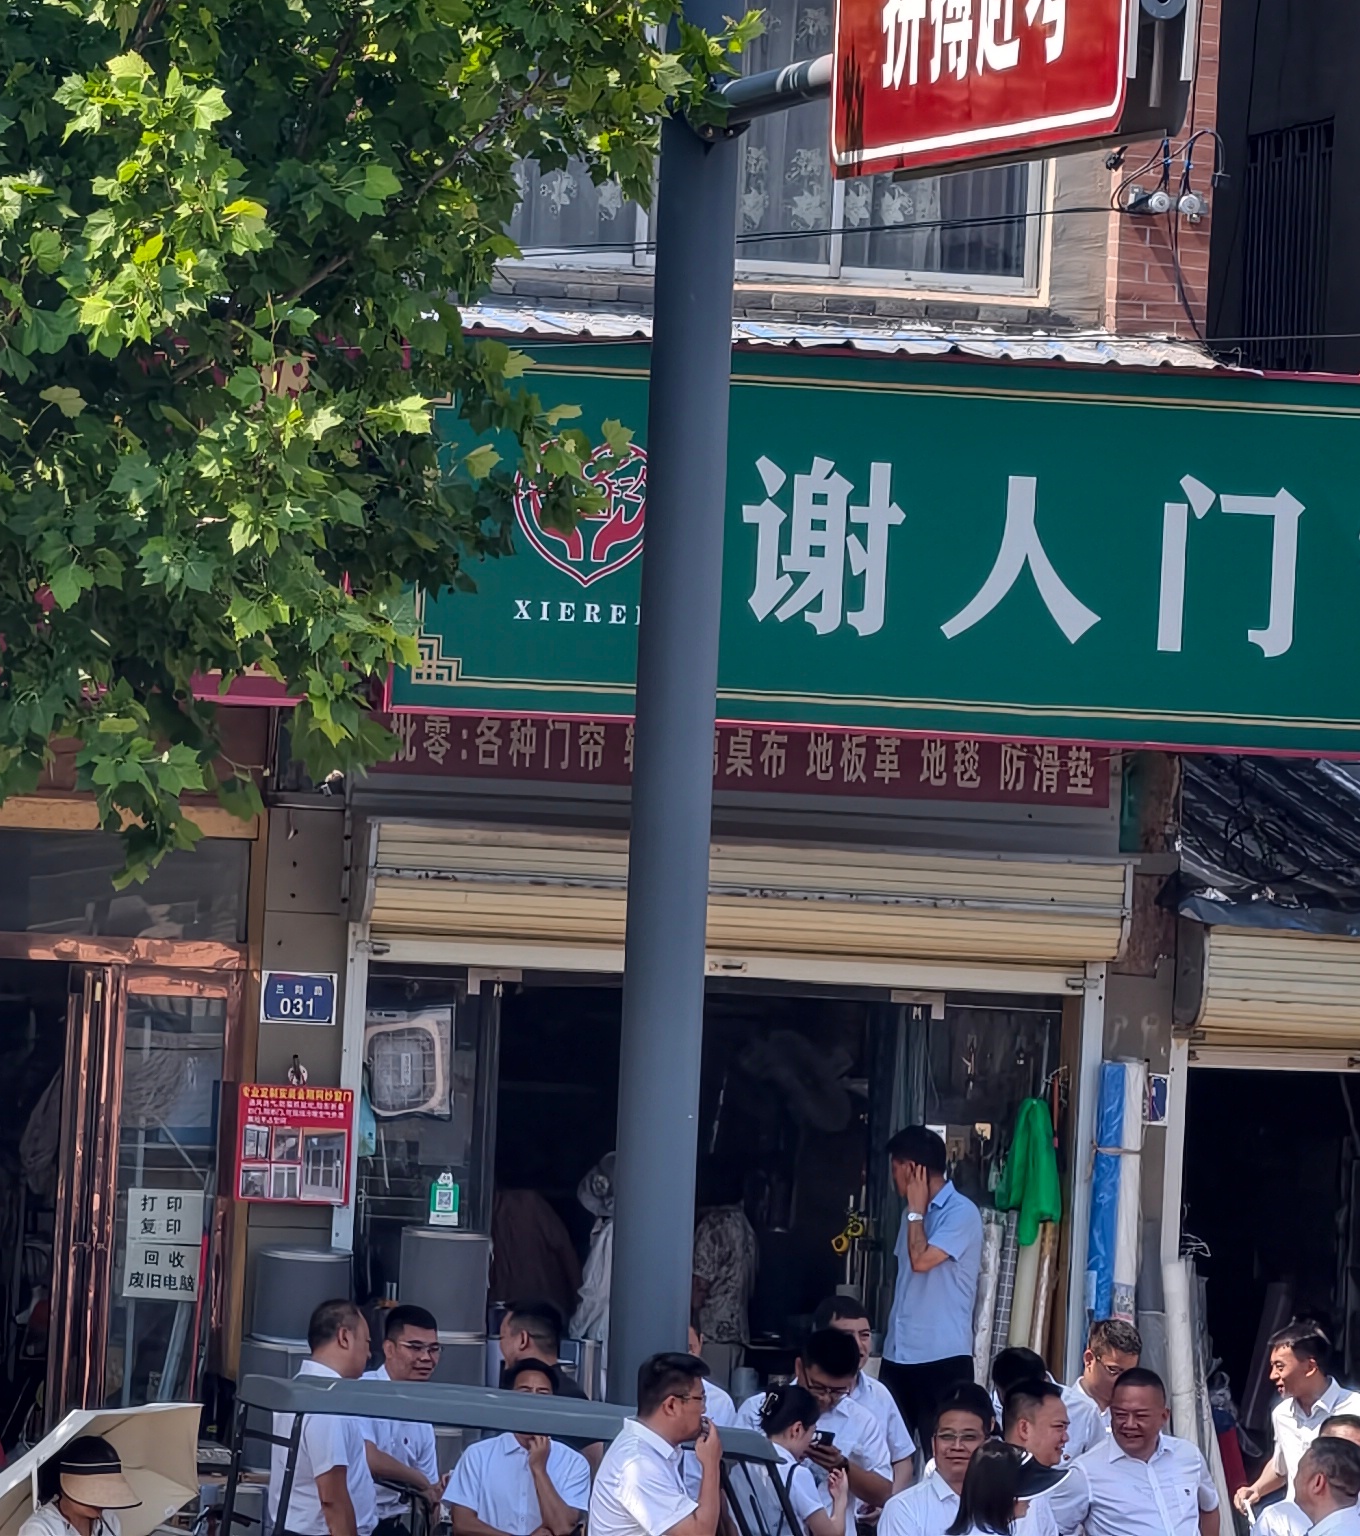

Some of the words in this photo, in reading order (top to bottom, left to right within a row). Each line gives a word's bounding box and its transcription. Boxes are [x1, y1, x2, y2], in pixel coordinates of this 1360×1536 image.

[513, 599, 640, 625] XIERE
[806, 731, 901, 784] 地板革
[919, 738, 981, 789] 地毯
[1000, 742, 1094, 795] 防滑垫
[280, 997, 314, 1016] 031
[141, 1194, 182, 1212] 打印
[141, 1218, 182, 1235] 复印
[144, 1250, 186, 1268] 回收
[128, 1271, 196, 1292] 废旧电脑
